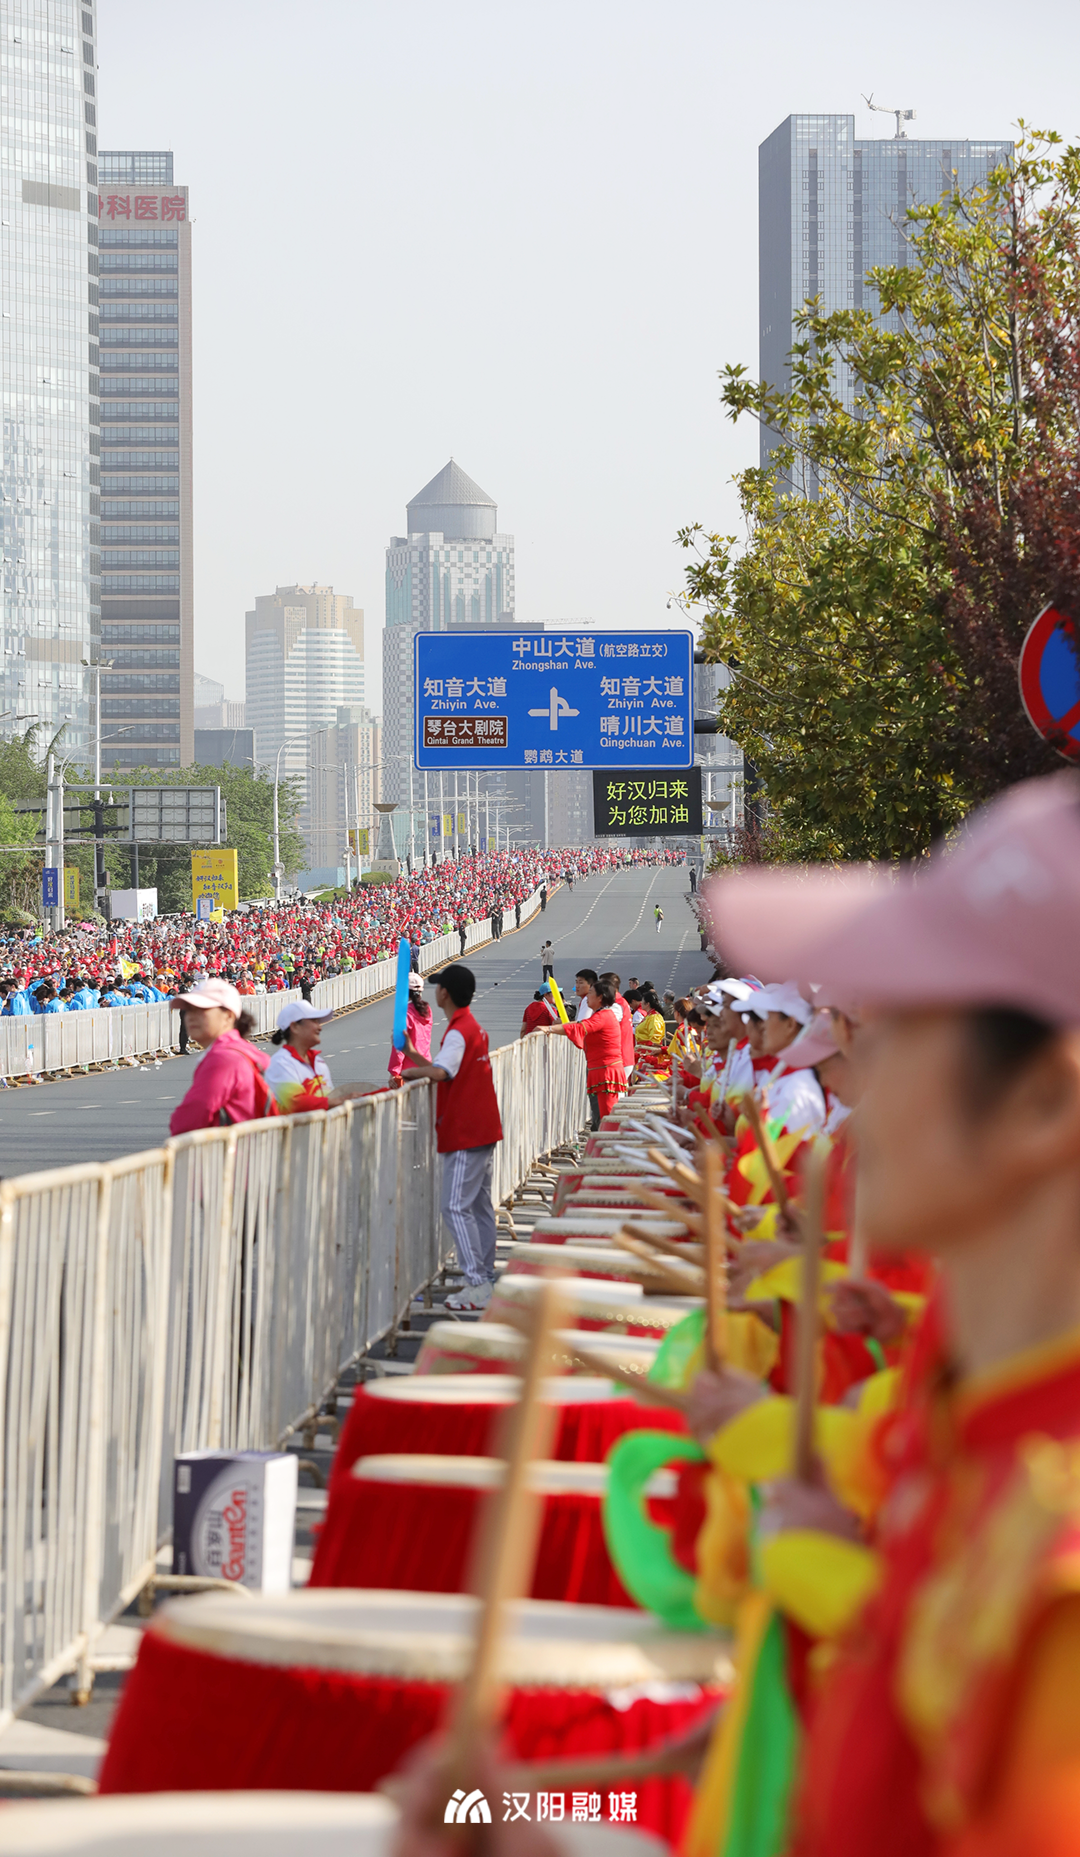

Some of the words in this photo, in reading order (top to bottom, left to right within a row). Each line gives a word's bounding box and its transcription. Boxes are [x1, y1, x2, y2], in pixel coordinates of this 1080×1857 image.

[99, 195, 185, 221] 科医院
[512, 637, 595, 658] 中山大道
[599, 643, 668, 658] (航空路立交)
[512, 660, 568, 672] Zhongshan
[574, 659, 597, 670] Ave.
[423, 677, 507, 698] 知音大道
[600, 676, 684, 697] 知音大道
[431, 699, 467, 711] Zhiyin
[474, 699, 500, 709] Ave.
[608, 698, 644, 710] Zhiyin
[651, 698, 677, 708] Ave.
[427, 720, 504, 736] 琴台大剧院
[600, 715, 685, 736] 晴川大道
[427, 737, 449, 745] Qintai
[452, 737, 474, 745] Grand
[477, 736, 504, 745] Theatre
[600, 737, 656, 750] Qingchuan
[662, 738, 685, 748] Ave.
[524, 750, 584, 764] 鹦鹉大道
[606, 779, 689, 802] 好汉归来
[608, 805, 689, 826] 为您加油
